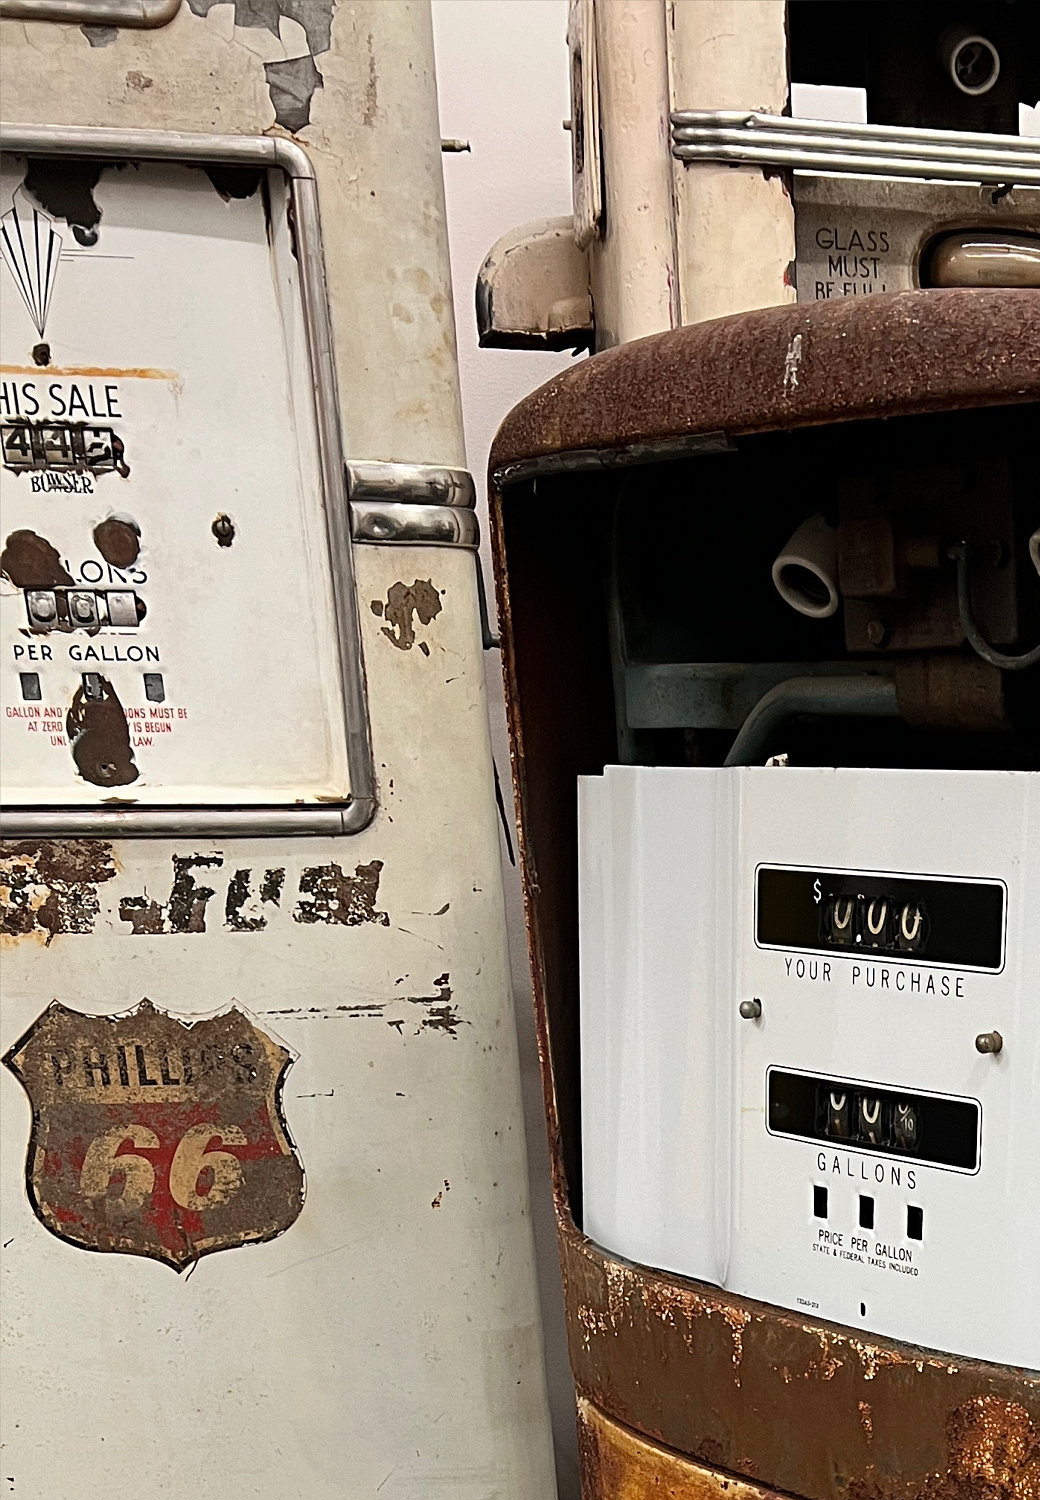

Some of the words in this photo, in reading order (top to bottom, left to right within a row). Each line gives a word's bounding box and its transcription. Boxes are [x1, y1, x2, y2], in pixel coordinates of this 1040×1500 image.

[815, 228, 890, 252] GLASS
[827, 255, 880, 279] MUST
[0, 382, 40, 416] HIS
[48, 383, 122, 418] SALE
[13, 645, 53, 661] PER
[68, 645, 160, 662] GALLON
[5, 707, 41, 718] GALLON
[43, 707, 63, 718] AND
[149, 708, 175, 719] MUST
[177, 709, 188, 720] BE
[27, 721, 38, 732] AT
[42, 721, 63, 732] ZERO
[133, 722, 142, 733] IS
[144, 722, 172, 733] BEGUN
[784, 957, 832, 982] YOUR
[851, 965, 966, 999] PURCHASE
[80, 1123, 249, 1211] 66
[816, 1152, 918, 1190] GALLONS
[812, 1242, 831, 1256] STATE
[839, 1249, 866, 1264] FEDERAL
[866, 1256, 887, 1269] TAXES
[888, 1262, 920, 1277] INCLUDED
[818, 1228, 845, 1247] PRICE
[850, 1236, 869, 1253] PER
[874, 1242, 913, 1263] GALLON
